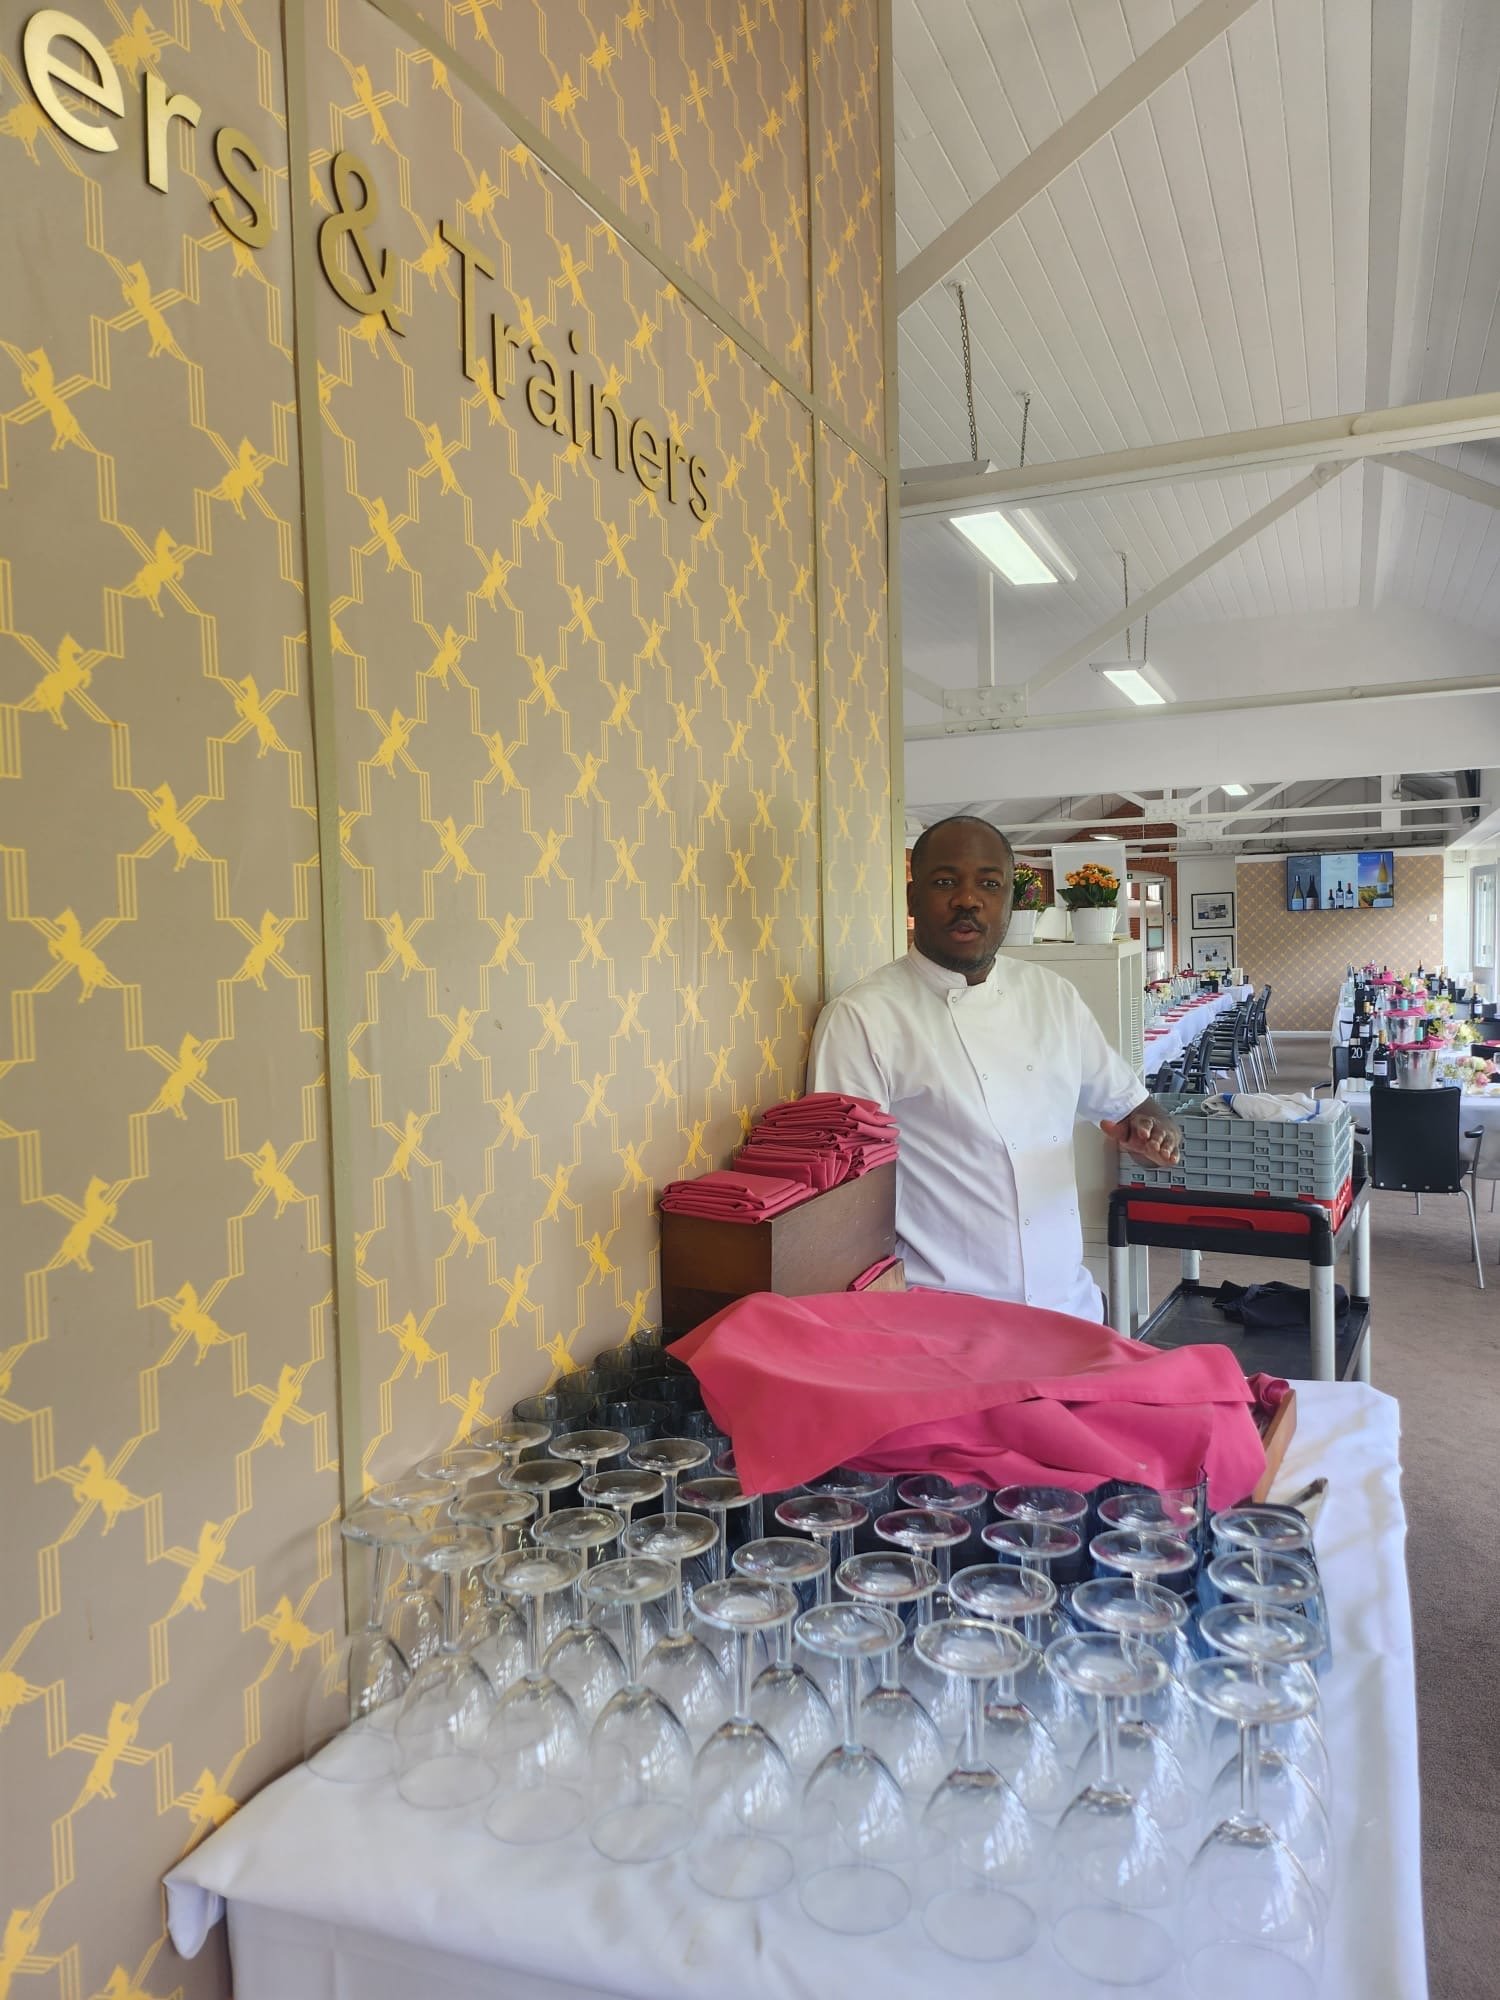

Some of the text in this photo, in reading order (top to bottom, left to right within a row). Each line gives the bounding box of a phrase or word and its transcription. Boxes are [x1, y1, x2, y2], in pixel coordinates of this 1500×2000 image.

[318, 151, 405, 337] &
[438, 219, 712, 523] Trainers
[1351, 1046, 1363, 1059] 20
